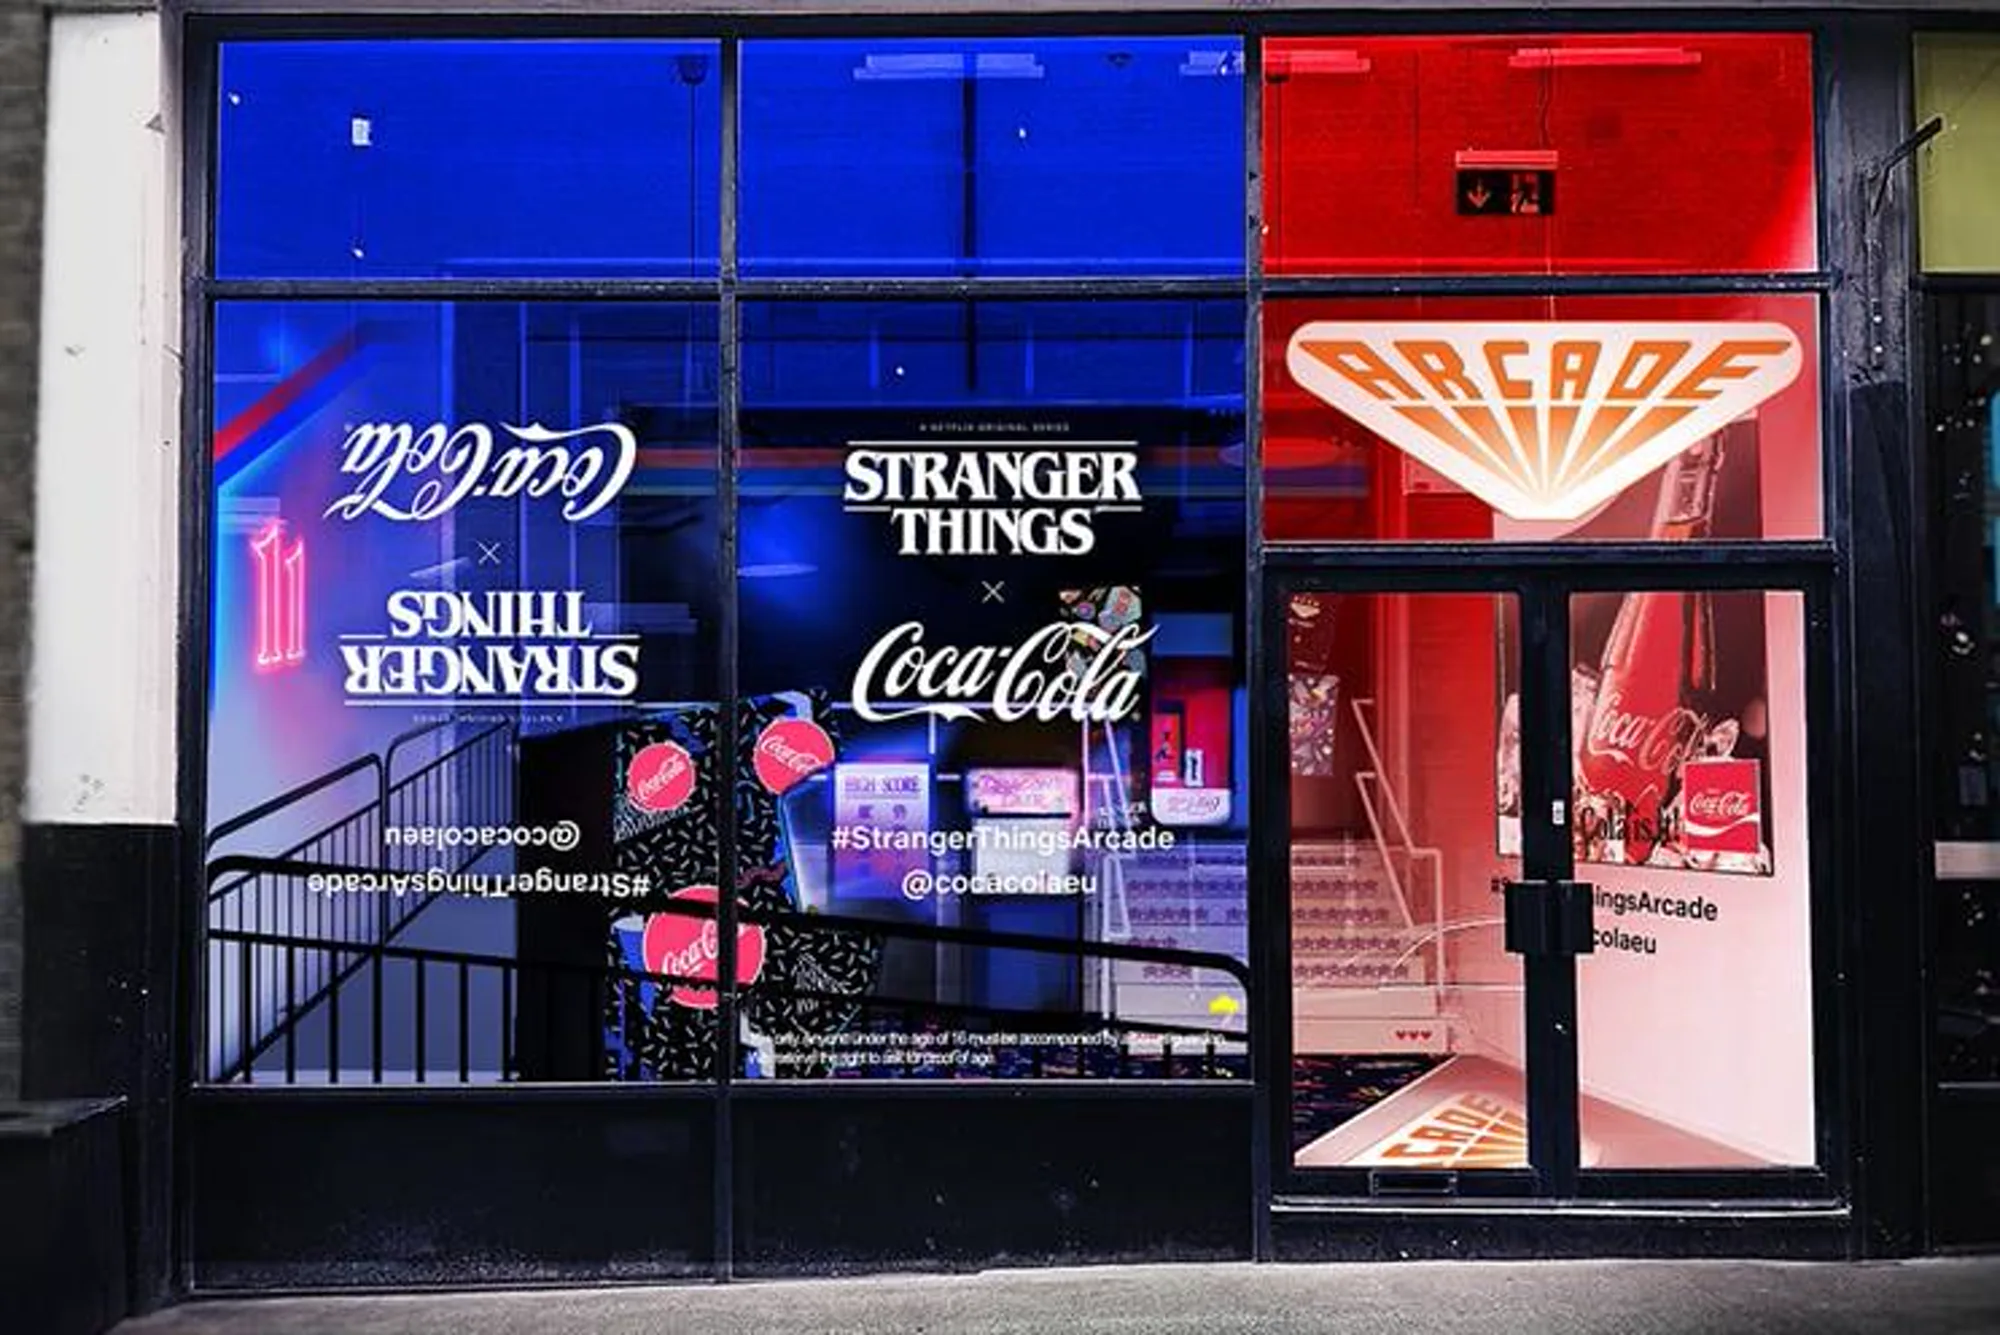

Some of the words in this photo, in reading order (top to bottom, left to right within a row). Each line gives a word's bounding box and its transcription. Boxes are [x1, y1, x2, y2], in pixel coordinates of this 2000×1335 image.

[1297, 340, 1793, 401] ARCADE
[323, 421, 637, 521] Coca-Cola
[844, 449, 1142, 501] STRANGER
[891, 507, 1095, 555] THINGS
[387, 591, 593, 638] THINGS
[339, 644, 641, 696] STRANGER
[852, 621, 1161, 723] Coca-Cola
[385, 820, 580, 852] @cocacolaeu
[831, 825, 1175, 855] #StrangerThingsArcade
[307, 867, 652, 898] #StrangerThingsArcade
[902, 870, 1097, 900] @cocacolaeu
[1380, 1092, 1503, 1159] CADE
